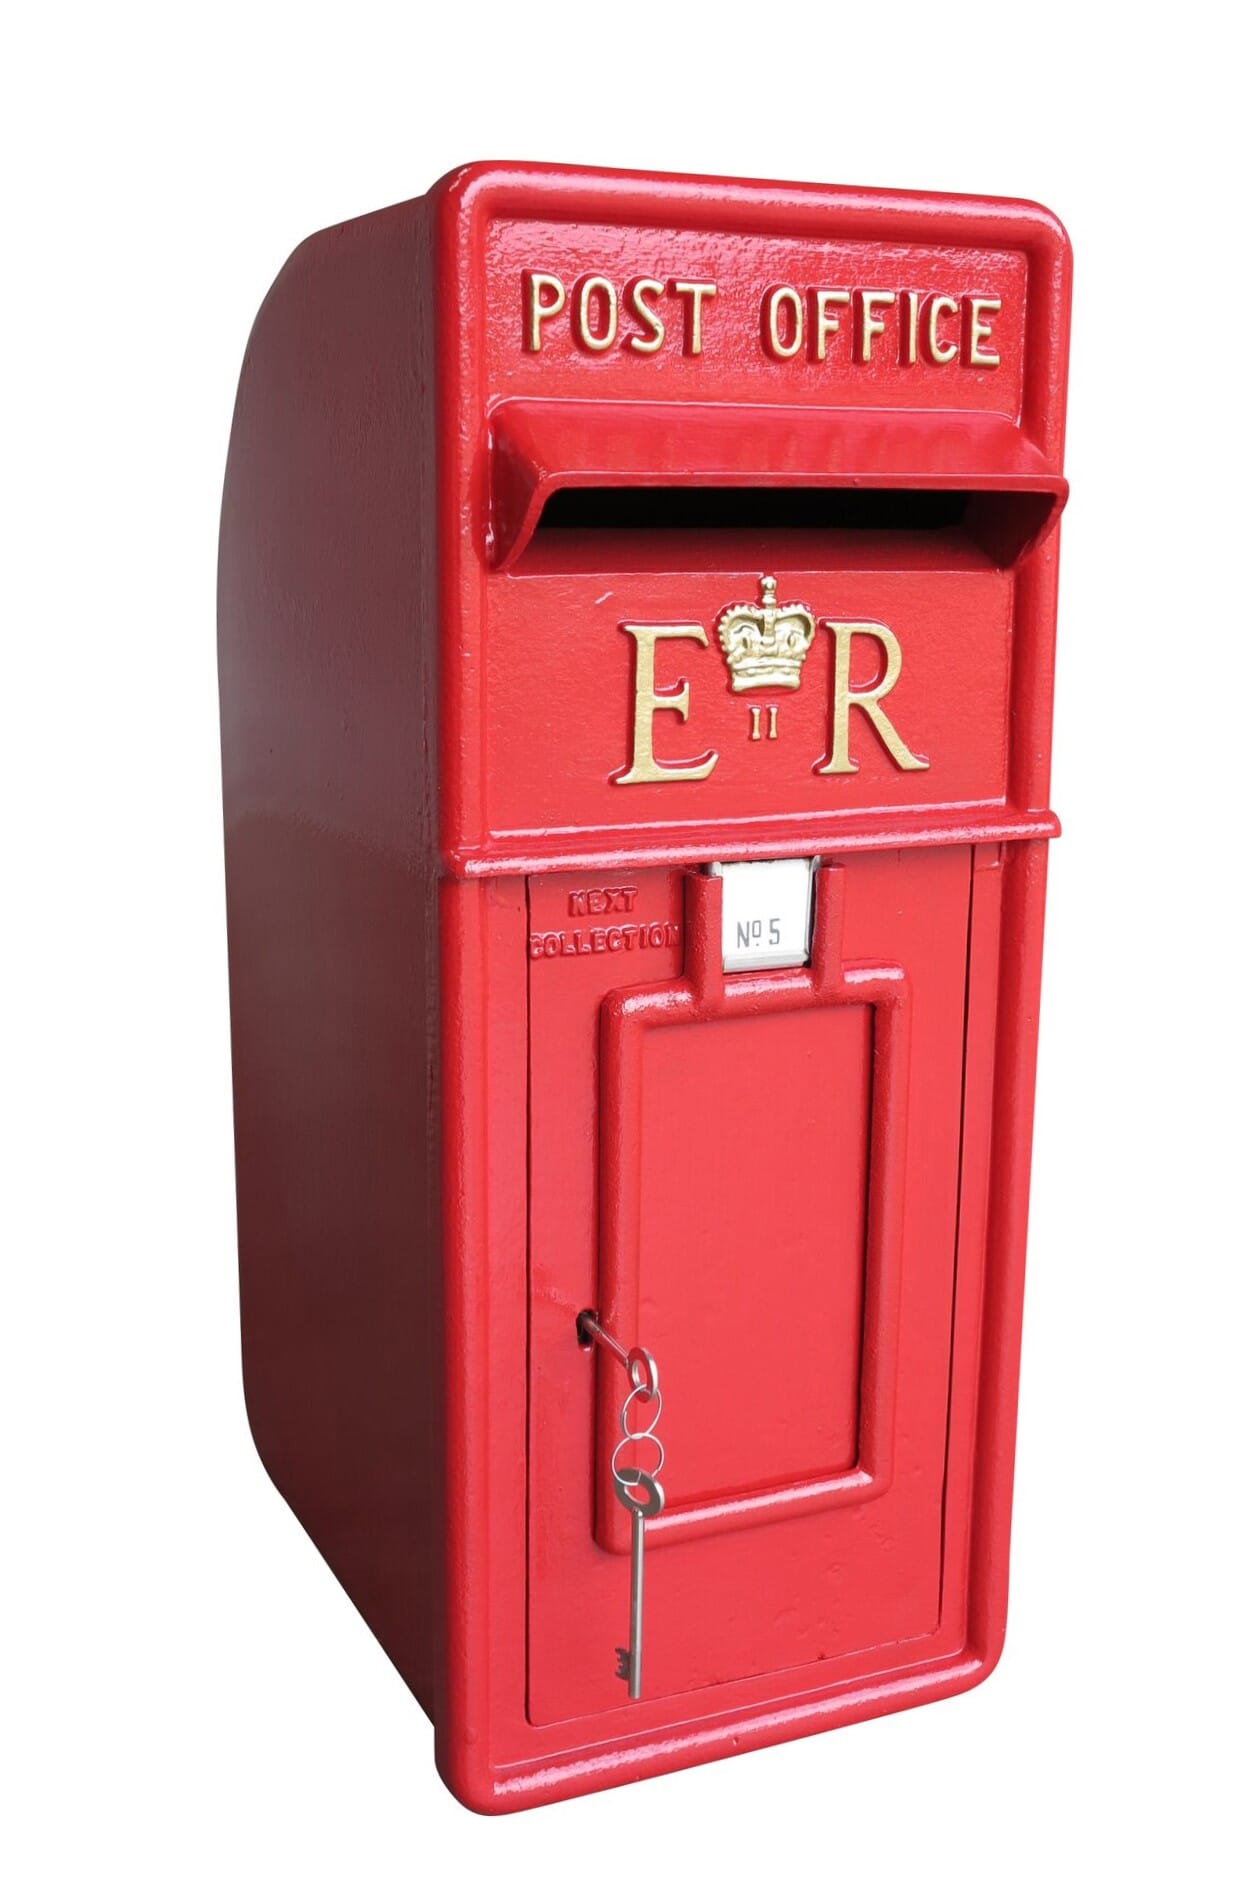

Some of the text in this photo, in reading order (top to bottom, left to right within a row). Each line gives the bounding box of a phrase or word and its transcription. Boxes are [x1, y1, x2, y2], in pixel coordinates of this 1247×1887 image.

[521, 270, 1001, 367] POST OFFICE
[611, 618, 930, 784] E R
[750, 704, 778, 740] II
[568, 886, 638, 917] NEXT
[530, 921, 681, 959] COLLECTION
[768, 917, 781, 946] 5
